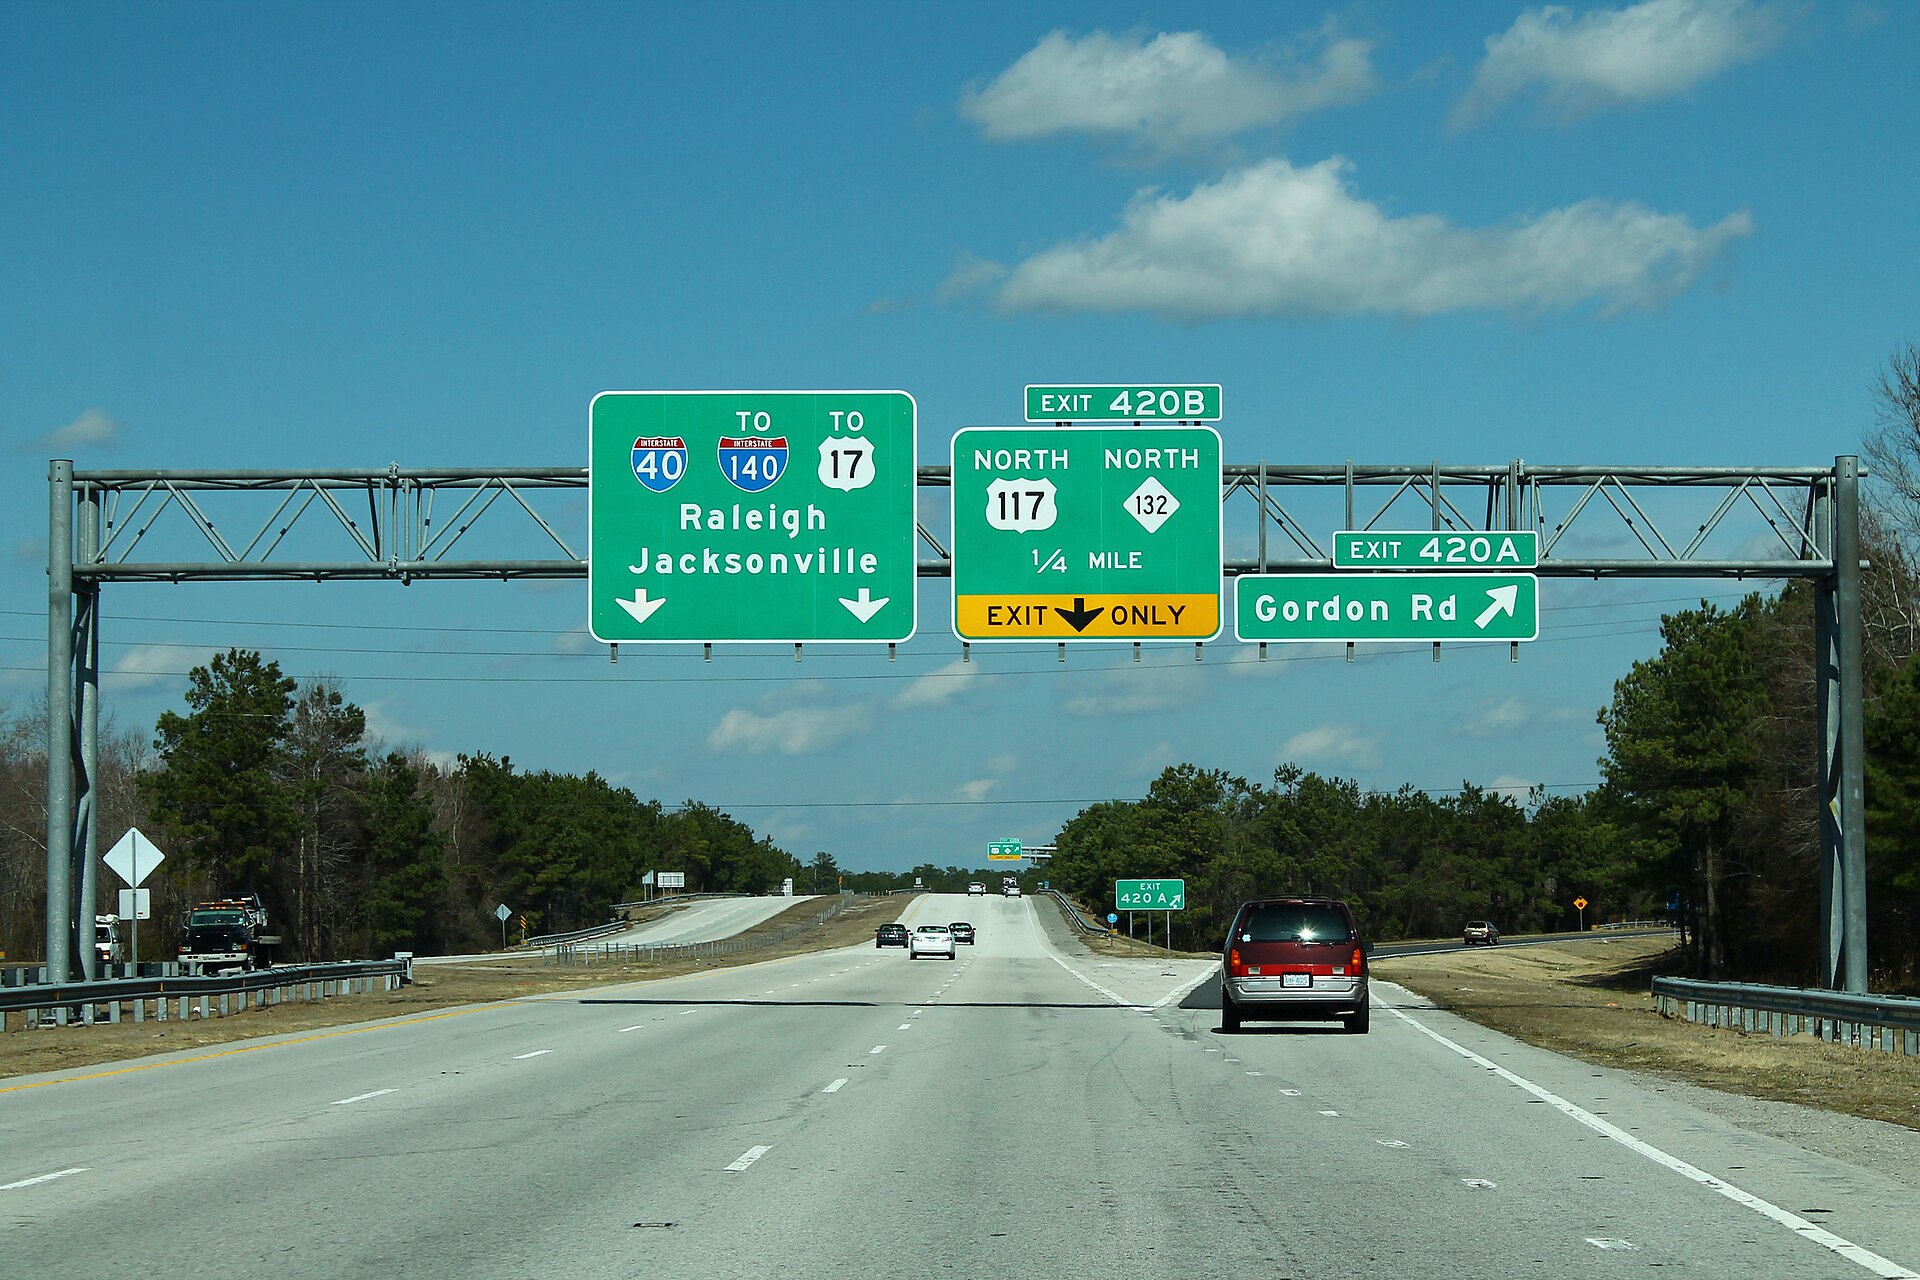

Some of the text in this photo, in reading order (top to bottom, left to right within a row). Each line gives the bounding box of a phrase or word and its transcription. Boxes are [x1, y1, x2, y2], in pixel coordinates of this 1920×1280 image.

[1041, 390, 1205, 416] EXIT 420B
[735, 411, 771, 432] TO
[829, 411, 864, 432] TO
[640, 439, 679, 447] INTERSTATE
[636, 451, 683, 480] 40
[730, 455, 778, 480] 140
[830, 449, 863, 479] 17
[974, 449, 1069, 470] NORTH
[1104, 448, 1199, 469] NORTH
[998, 491, 1045, 520] 117
[1135, 495, 1168, 515] 132
[680, 503, 826, 539] Raleigh
[1089, 551, 1143, 570] MILE
[1350, 537, 1520, 563] EXIT 420A
[628, 547, 878, 575] Jacksonville
[987, 605, 1186, 626] EXIT ONLY
[1255, 594, 1457, 622] Gordon Rd
[1140, 883, 1160, 891] EXIT
[1120, 893, 1167, 904] 420 A
